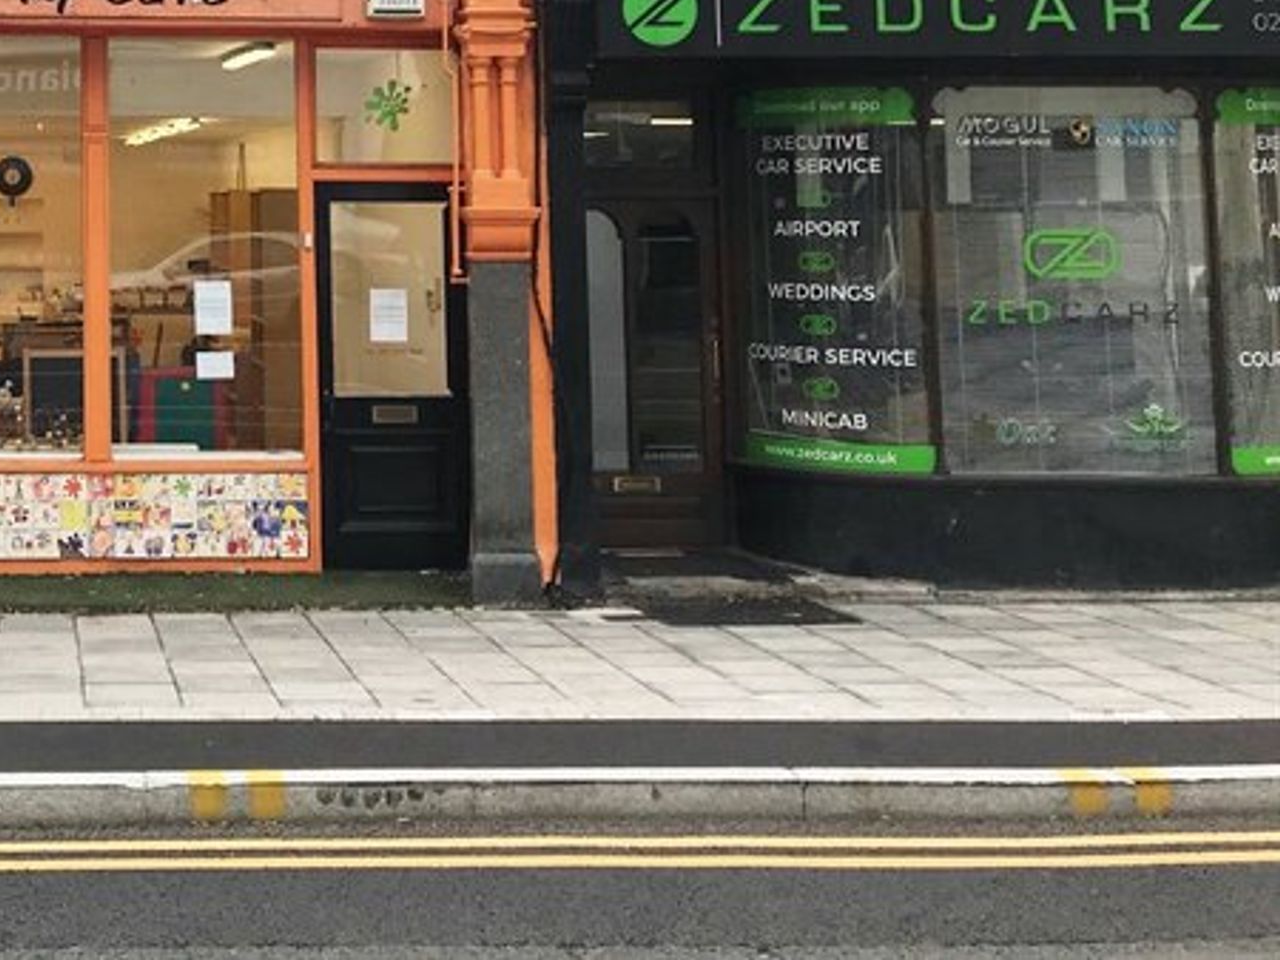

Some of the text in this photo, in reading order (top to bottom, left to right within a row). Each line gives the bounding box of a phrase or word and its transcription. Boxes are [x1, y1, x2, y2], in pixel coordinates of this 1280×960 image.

[958, 115, 1051, 134] MOGUL
[762, 133, 869, 152] EXECUTIVE
[756, 157, 883, 175] CAR SERVICE
[773, 220, 861, 238] AIRPORT
[768, 282, 876, 302] WEDDINGS
[748, 343, 917, 367] COURIER SERVICE
[781, 408, 869, 430] MINICAB
[765, 445, 898, 465] www.zedcarz.co.uk
